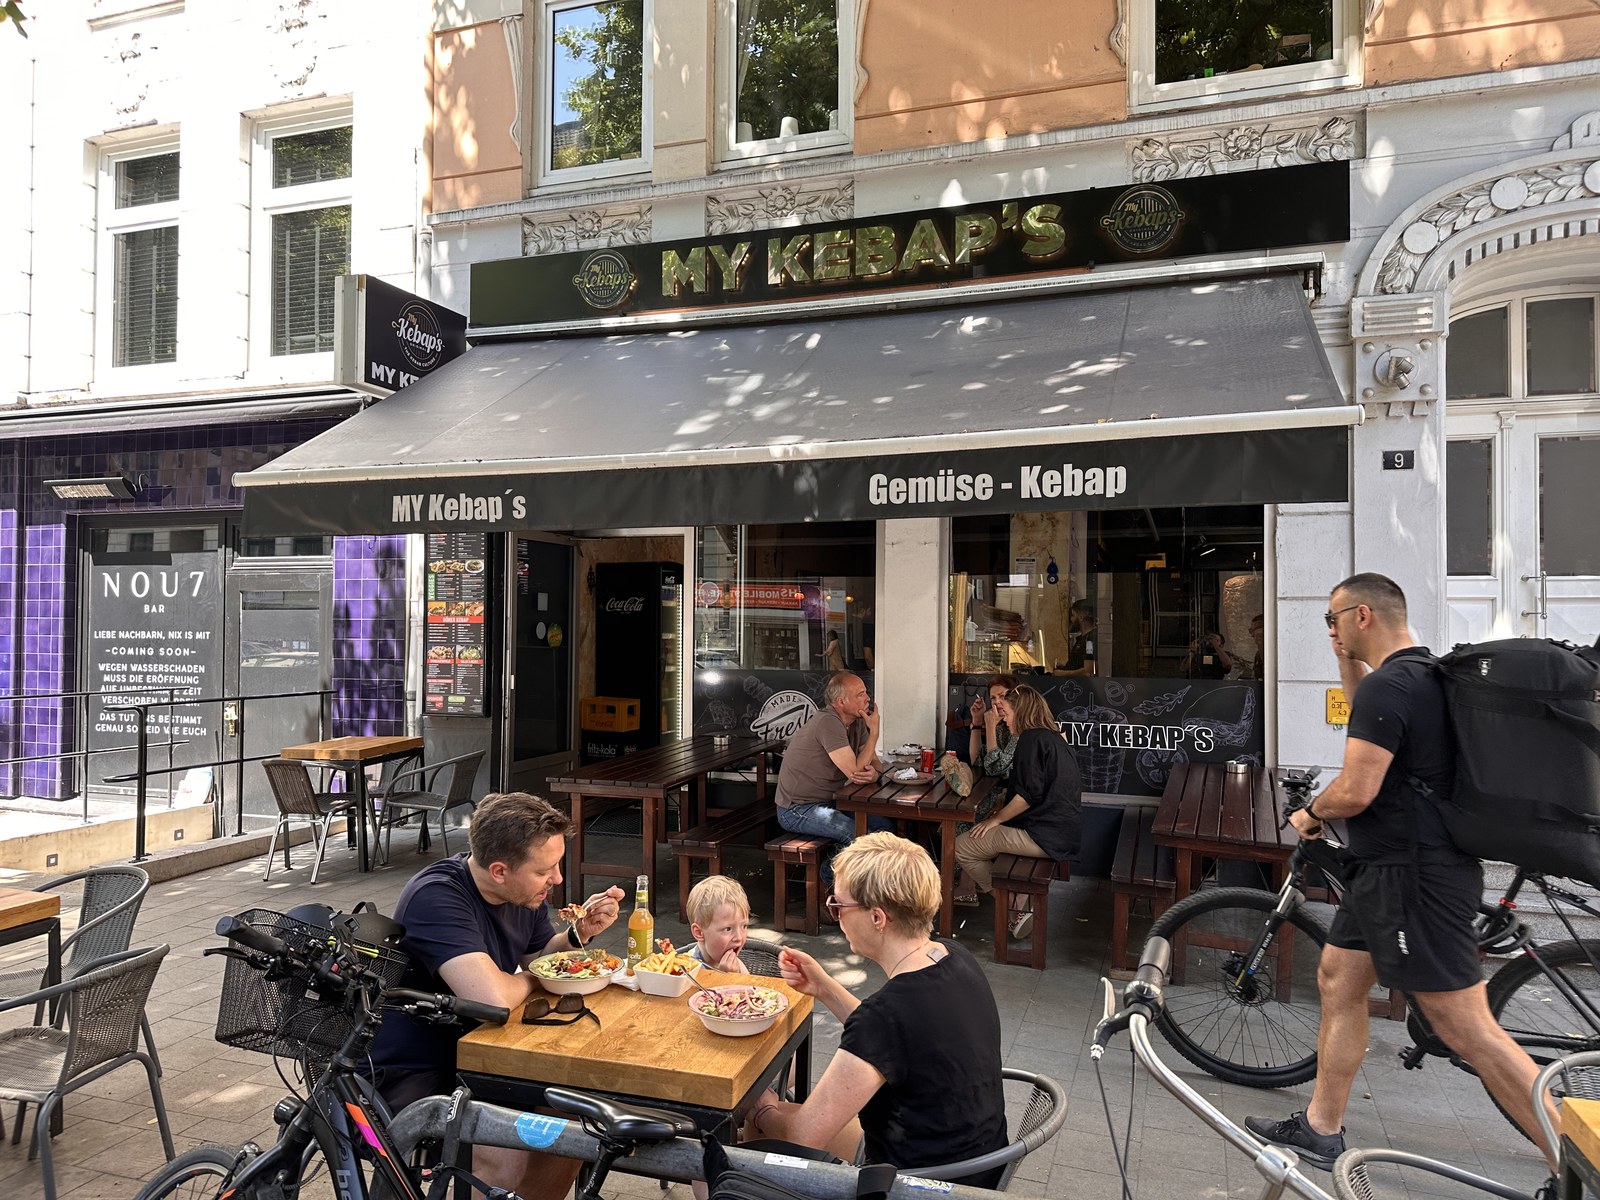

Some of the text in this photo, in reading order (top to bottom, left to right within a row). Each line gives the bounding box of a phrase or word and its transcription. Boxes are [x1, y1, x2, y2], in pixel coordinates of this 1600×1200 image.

[662, 203, 1066, 296] MY KEBAP'S
[407, 312, 418, 326] My
[393, 317, 443, 354] Kebap's
[371, 361, 396, 385] MY
[1394, 452, 1404, 468] 9
[869, 469, 994, 505] Gemüse
[1020, 463, 1127, 499] Kebap
[392, 494, 424, 522] MY
[143, 604, 165, 613] BAR
[94, 631, 210, 640] LIEBE NACHBARN, NIX IS MIT
[98, 663, 205, 673] WEGEN WASSERSCHADEN
[103, 674, 199, 684] MUSS DIE ERÖFFNUNG
[120, 685, 179, 695] UNBESTIMME
[182, 687, 202, 695] ZEIT
[101, 695, 199, 706] VERSCHOBEN WRDEN.
[771, 695, 797, 708] MADE
[100, 713, 116, 721] DAS
[119, 714, 135, 722] TUT
[95, 724, 124, 732] GENAU
[126, 725, 138, 733] SO
[182, 726, 207, 736] EUCH
